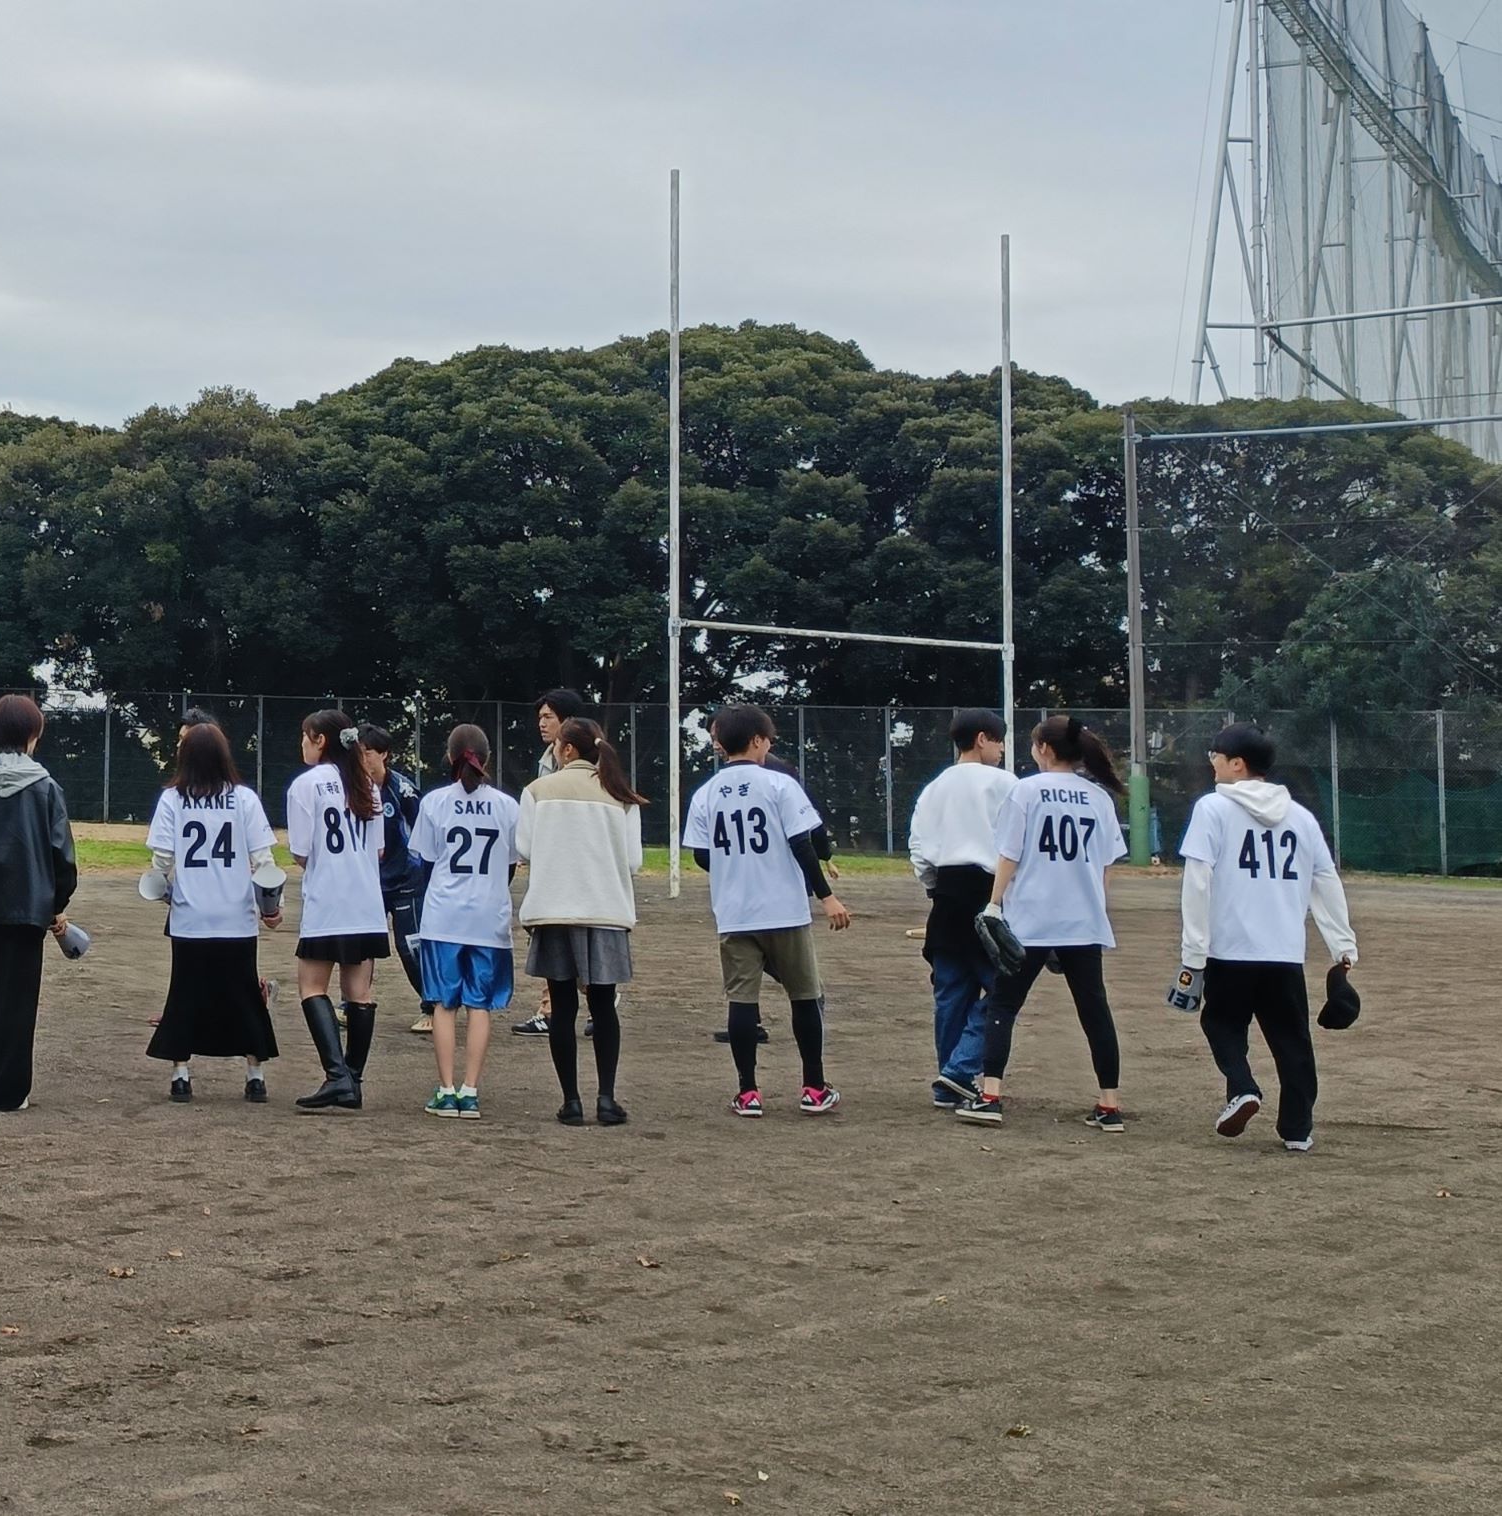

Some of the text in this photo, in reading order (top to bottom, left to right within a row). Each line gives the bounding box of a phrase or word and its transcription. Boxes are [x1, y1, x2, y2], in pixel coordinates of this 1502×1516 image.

[182, 795, 235, 810] AKANE
[454, 800, 492, 816] SAKI
[719, 782, 751, 798] やぎ
[1040, 788, 1090, 805] RICHE
[182, 820, 236, 869] 24
[446, 825, 500, 875] 27
[713, 806, 769, 856] 413
[1039, 814, 1096, 863] 407
[1238, 829, 1299, 881] 412
